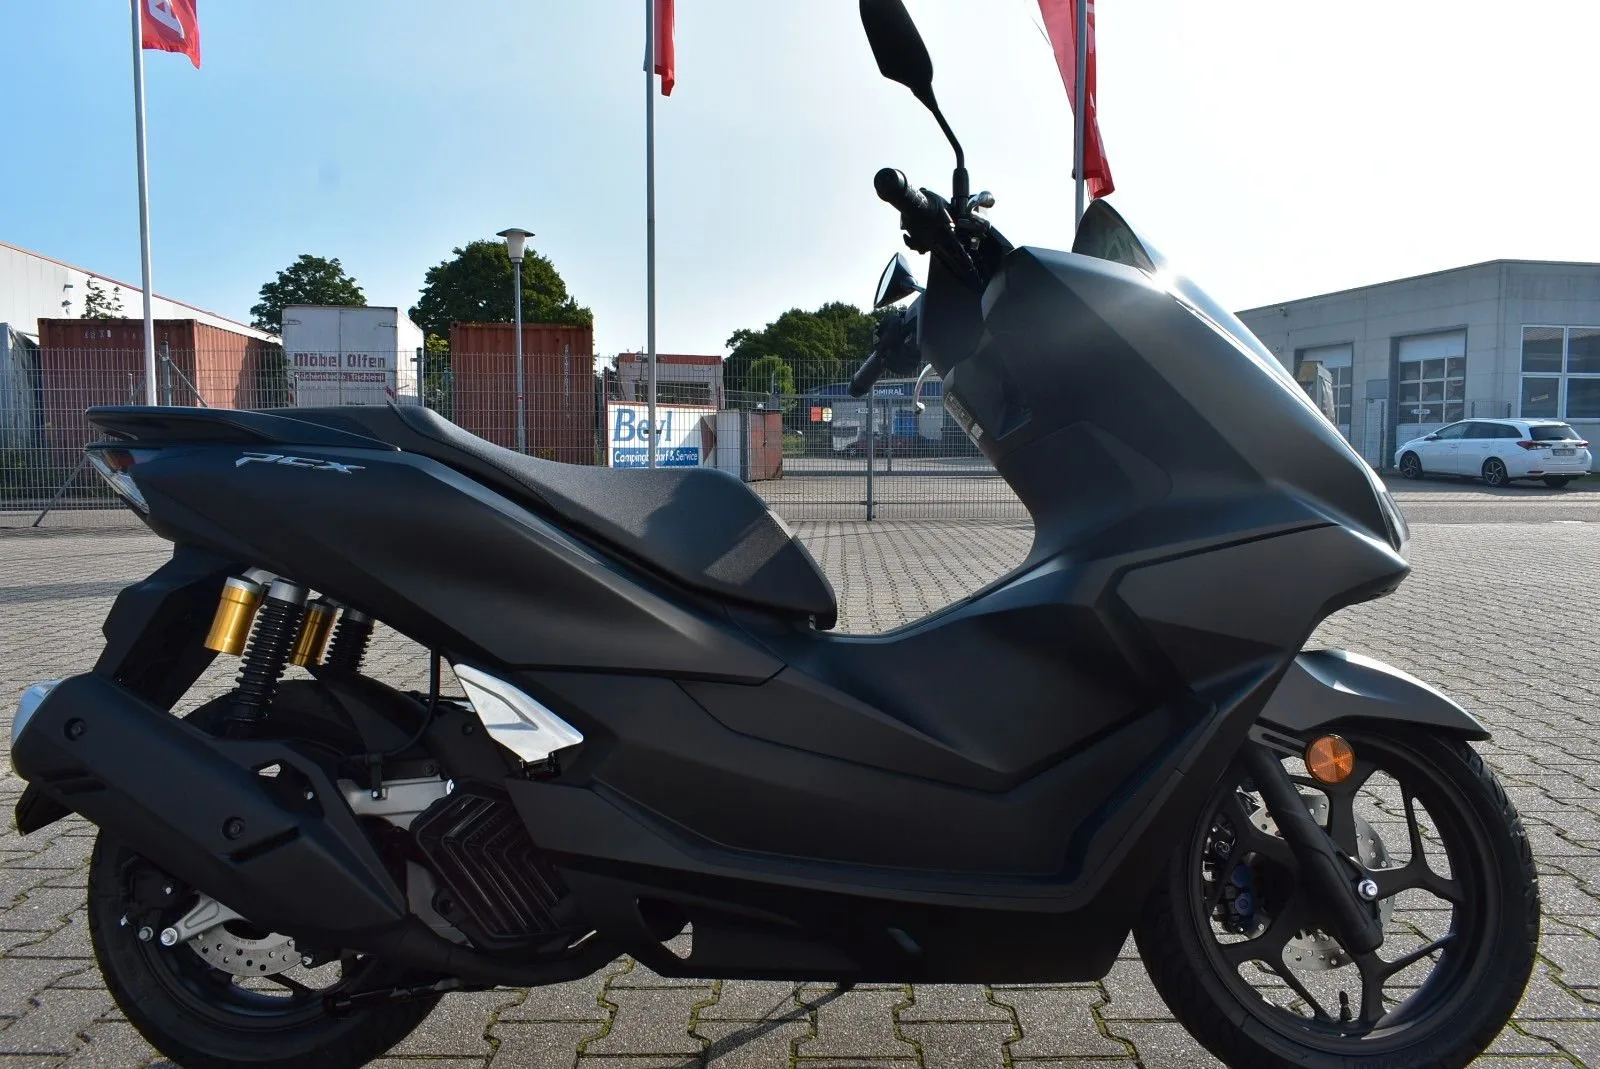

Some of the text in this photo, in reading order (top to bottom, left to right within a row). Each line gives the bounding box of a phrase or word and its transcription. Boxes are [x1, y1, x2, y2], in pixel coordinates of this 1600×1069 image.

[294, 353, 386, 368] Möbel Olfen
[866, 388, 904, 396] DMIRAL
[669, 450, 675, 461] &
[675, 450, 698, 461] Service
